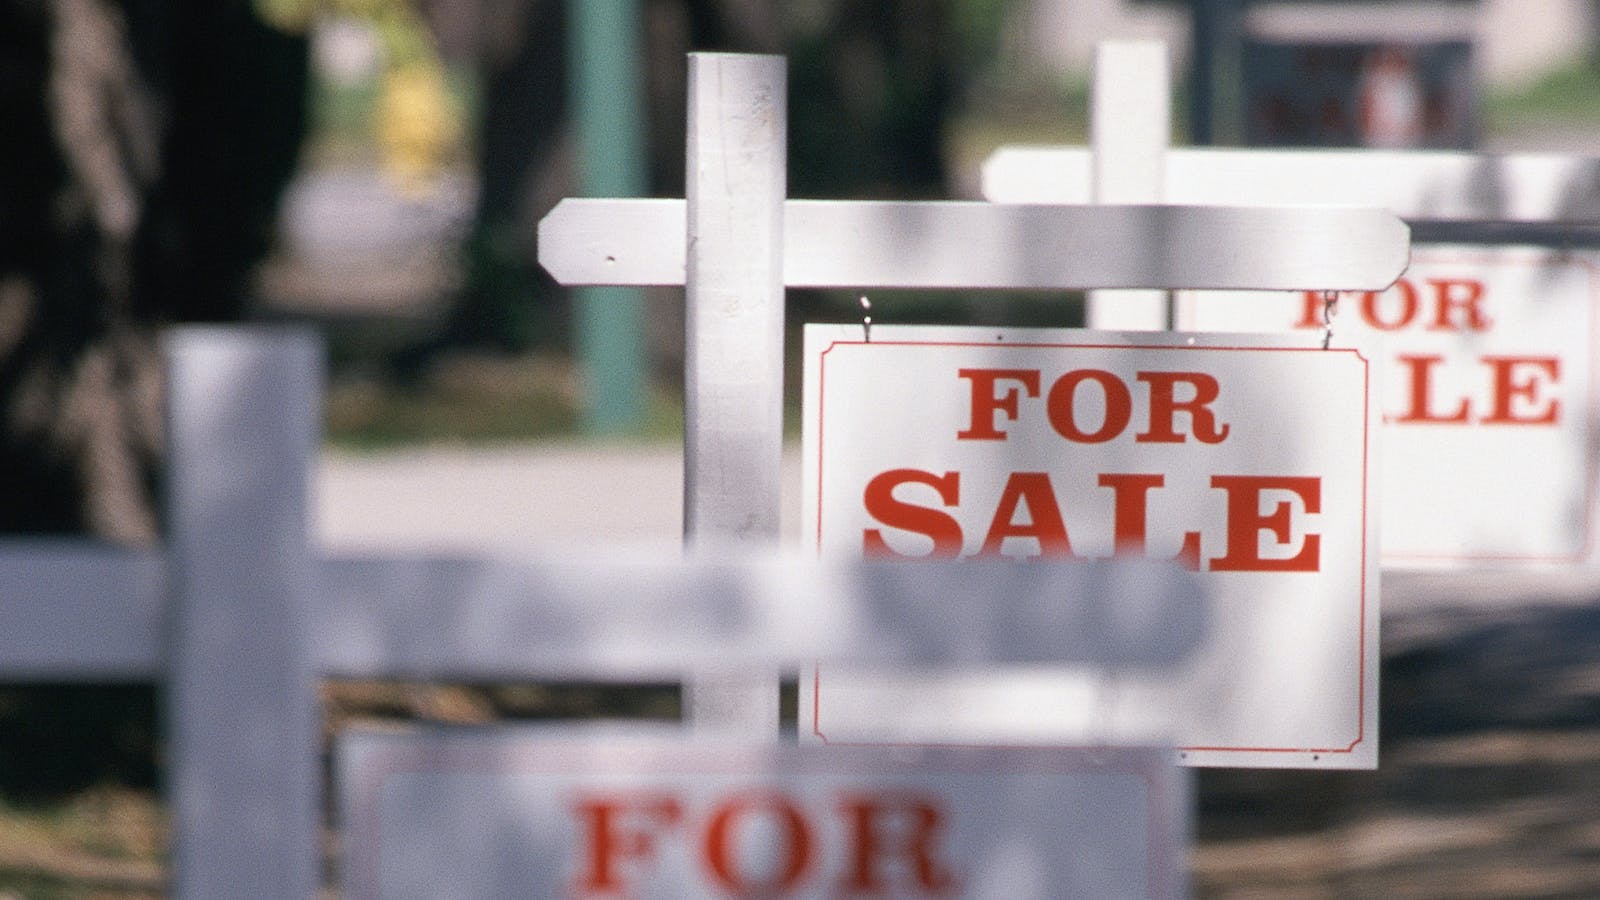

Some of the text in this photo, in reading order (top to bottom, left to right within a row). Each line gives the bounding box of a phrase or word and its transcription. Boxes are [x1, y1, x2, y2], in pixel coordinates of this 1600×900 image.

[958, 369, 1229, 444] FOR
[1383, 354, 1561, 425] LE
[864, 468, 1321, 572] SALE
[572, 790, 955, 898] FOR
